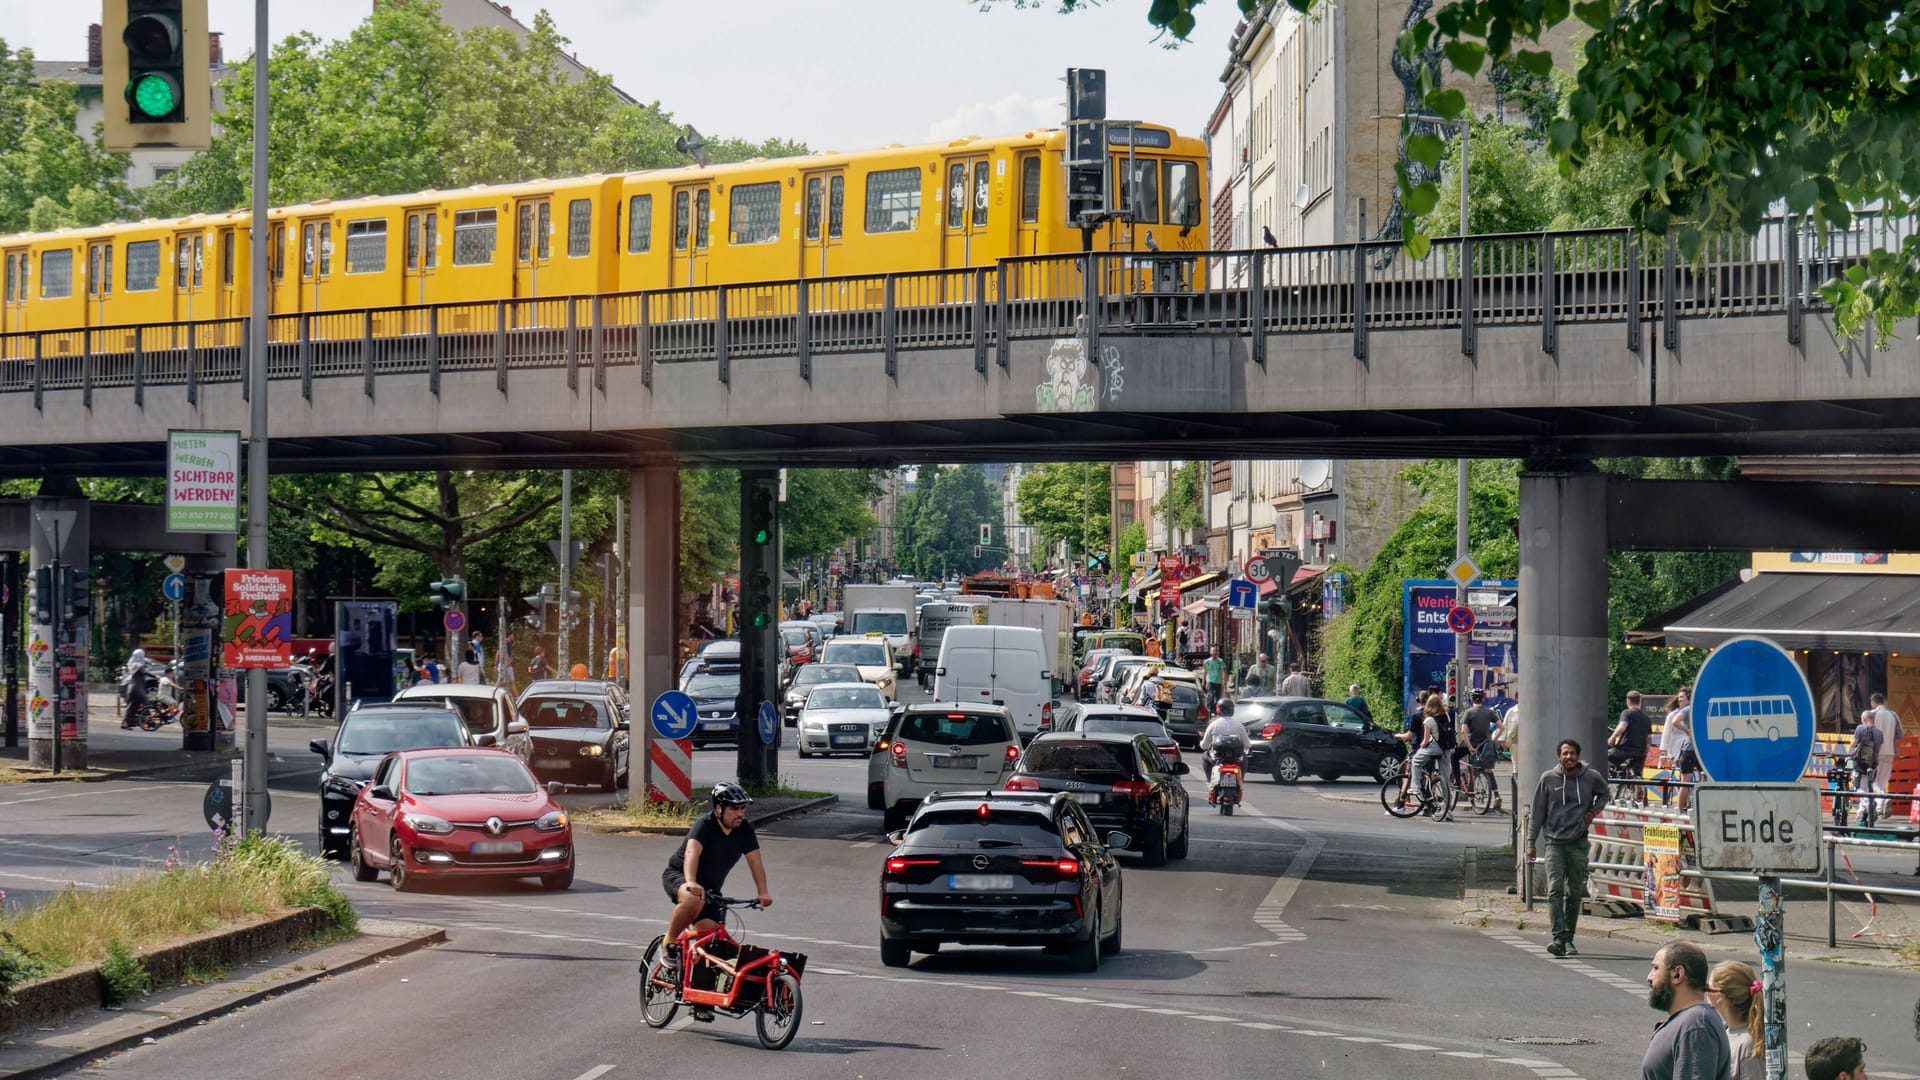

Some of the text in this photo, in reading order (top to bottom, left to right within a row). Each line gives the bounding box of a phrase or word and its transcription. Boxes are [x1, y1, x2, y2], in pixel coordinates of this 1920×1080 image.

[1138, 137, 1159, 145] Lanke
[173, 440, 206, 449] MIETEN
[175, 453, 215, 468] WERBEN
[174, 470, 234, 483] SICHTBAR
[174, 488, 234, 502] WERDEN!
[1250, 564, 1268, 577] 30
[241, 574, 279, 583] Frieden
[232, 583, 287, 592] Solidarität
[240, 592, 280, 600] Freiheit
[1417, 595, 1457, 609] Wenig
[1417, 611, 1449, 623] Ents
[1722, 810, 1793, 843] Ende
